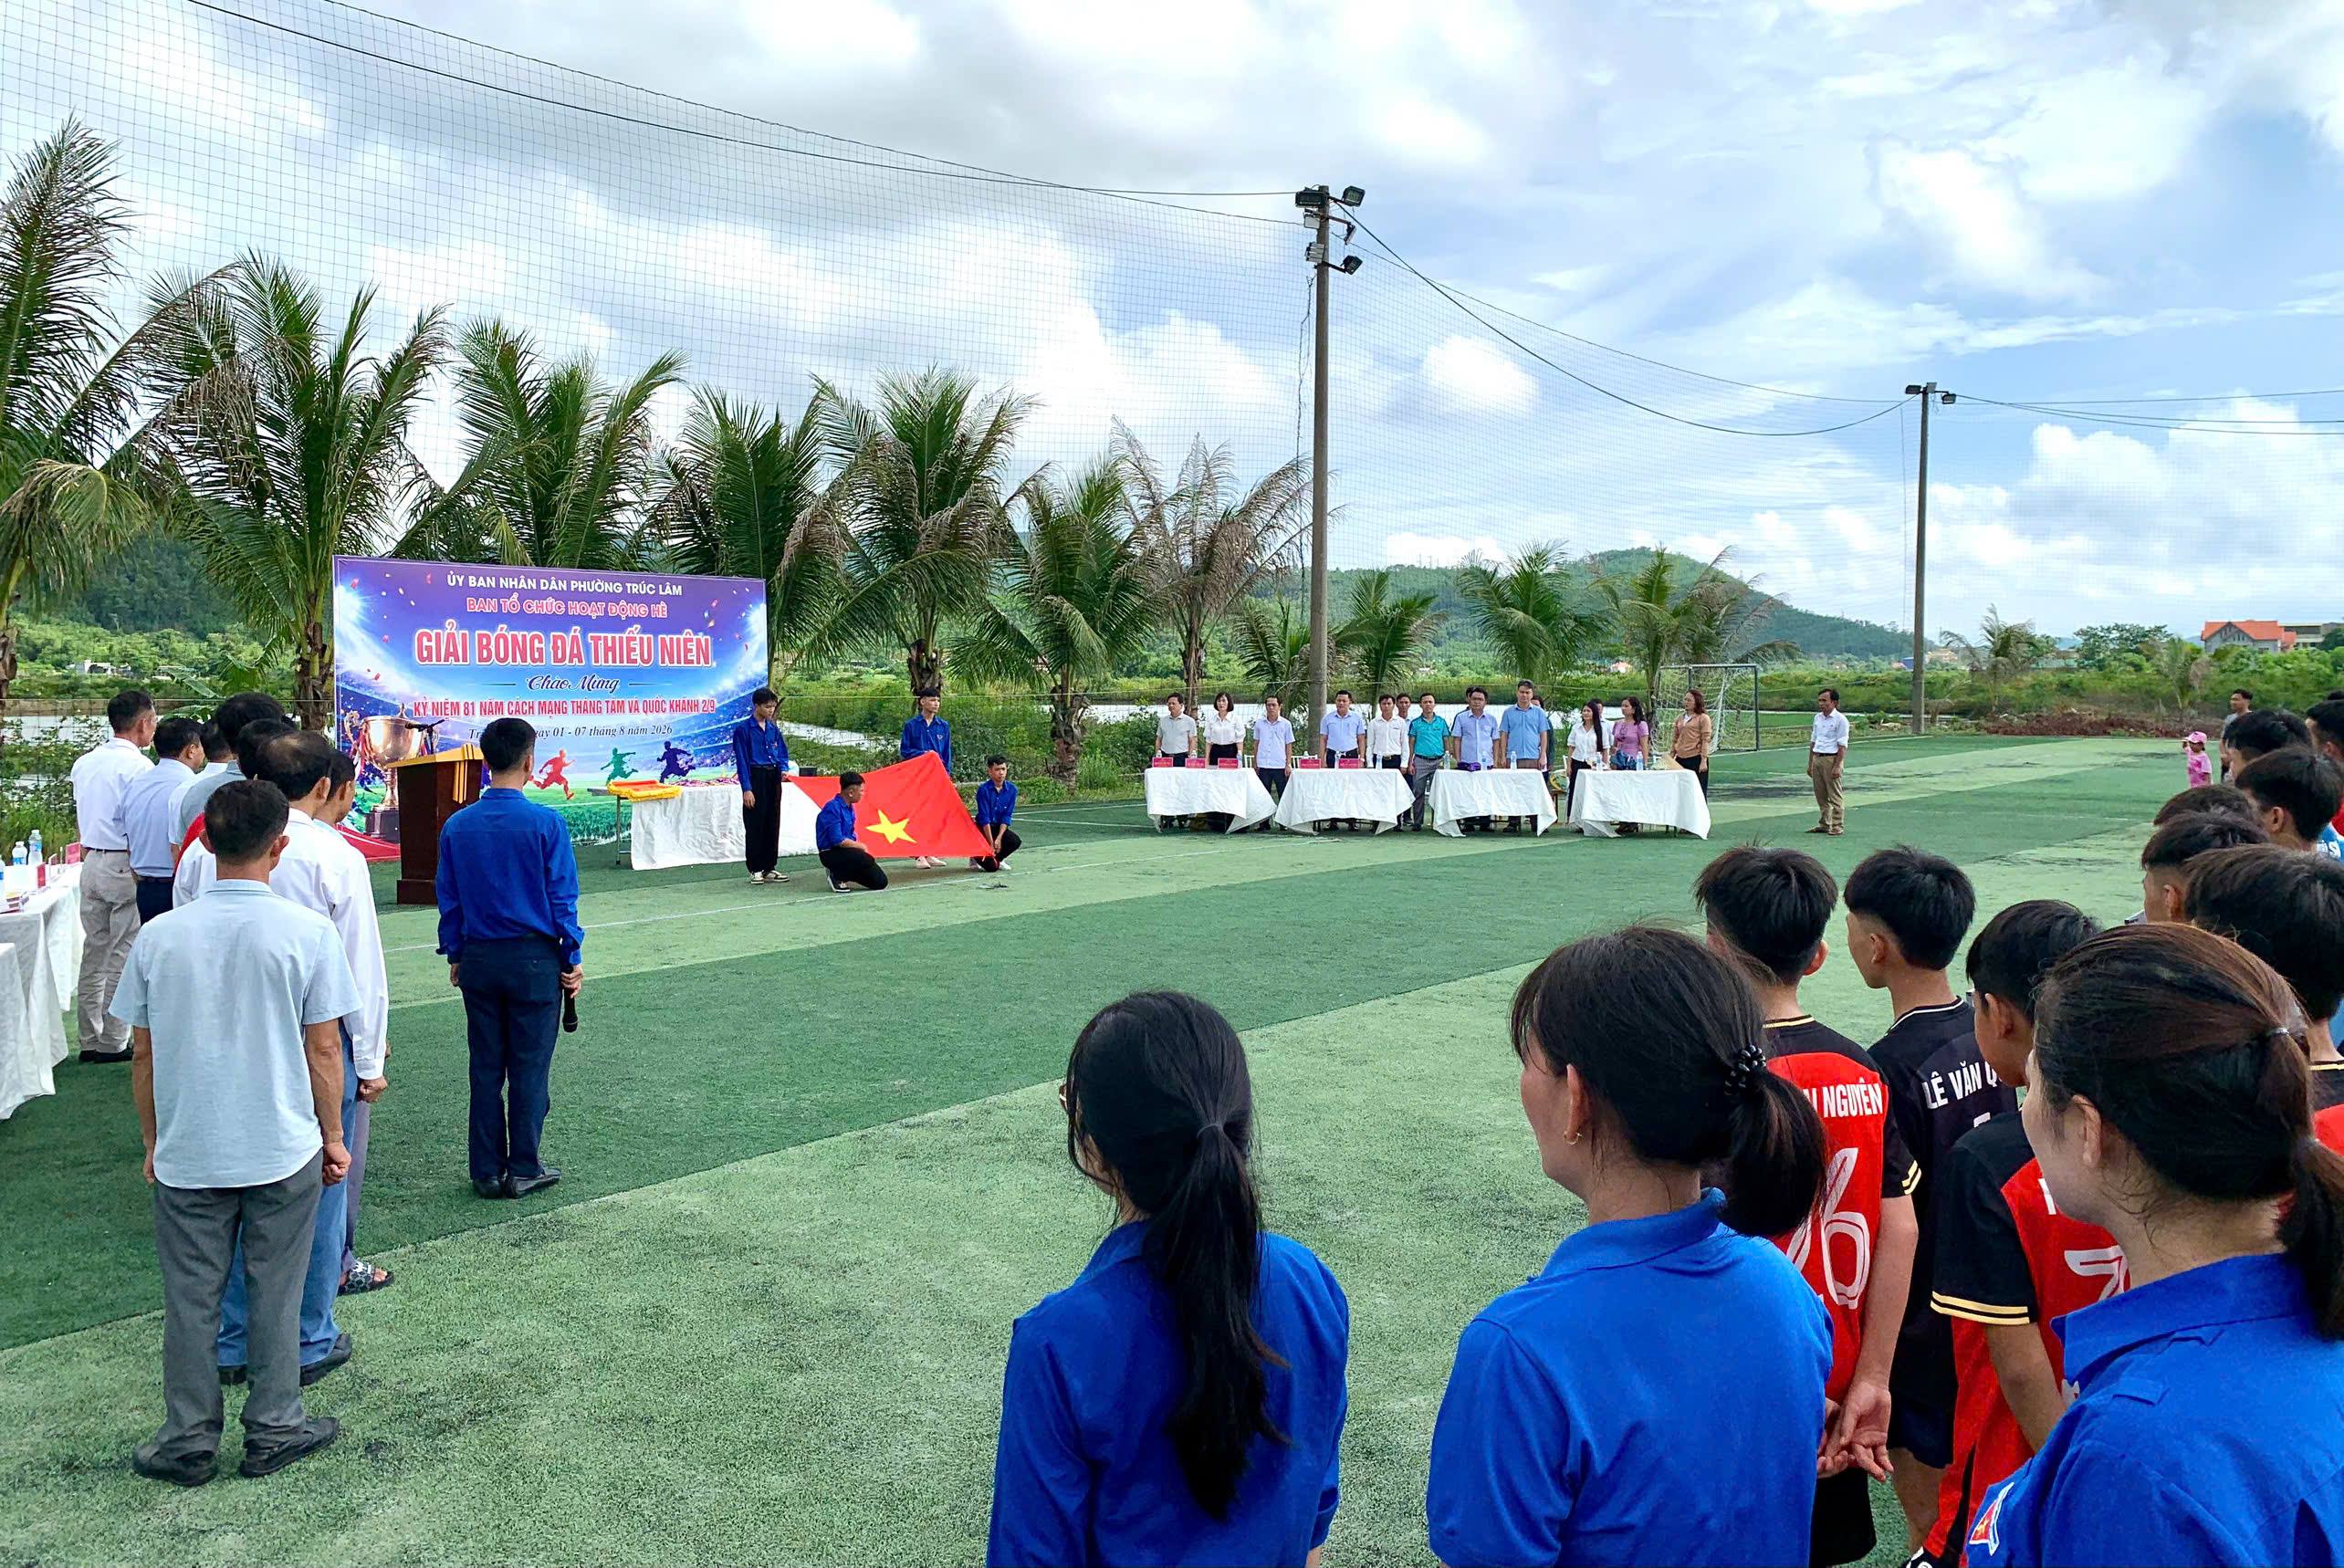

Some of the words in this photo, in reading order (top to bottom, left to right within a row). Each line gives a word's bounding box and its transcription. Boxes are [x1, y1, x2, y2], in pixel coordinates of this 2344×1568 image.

[446, 570, 464, 587] ỦY
[468, 575, 496, 588] BAN
[499, 575, 537, 590] NHÂN
[539, 577, 566, 591] DÂN
[570, 580, 623, 593] PHƯỜNG
[625, 582, 655, 595] TRÚC
[658, 583, 683, 596] LÂM
[466, 598, 497, 612] BAN
[499, 591, 520, 613] TỔ
[523, 597, 566, 614] CHỨC
[568, 601, 605, 619] HOẠT
[608, 601, 649, 620] ĐỘNG
[651, 601, 667, 618] HÈ
[415, 619, 469, 665] GIẢI
[476, 624, 545, 666] BÓNG
[550, 626, 585, 666] ĐÁ
[589, 625, 654, 666] THIẾU
[659, 630, 711, 667] NIÊN
[527, 674, 570, 691] Chào
[576, 674, 620, 694] Mừng
[431, 698, 460, 720] NIỆM
[463, 701, 476, 717] 81
[479, 698, 505, 716] NĂM
[507, 696, 535, 716] CÁCH
[538, 700, 568, 719] MẠNG
[570, 697, 602, 716] THÁNG
[642, 695, 667, 714] QUỐC
[669, 696, 700, 713] KHÁNH
[702, 698, 716, 714] 2/9
[552, 727, 564, 737] 01
[574, 727, 586, 737] 07
[589, 725, 617, 737] tháng
[619, 725, 625, 736] 8
[627, 726, 648, 736] năm
[651, 725, 673, 735] 2026
[1921, 1071, 1949, 1110] LÊ
[1948, 1061, 1983, 1101] VĂN
